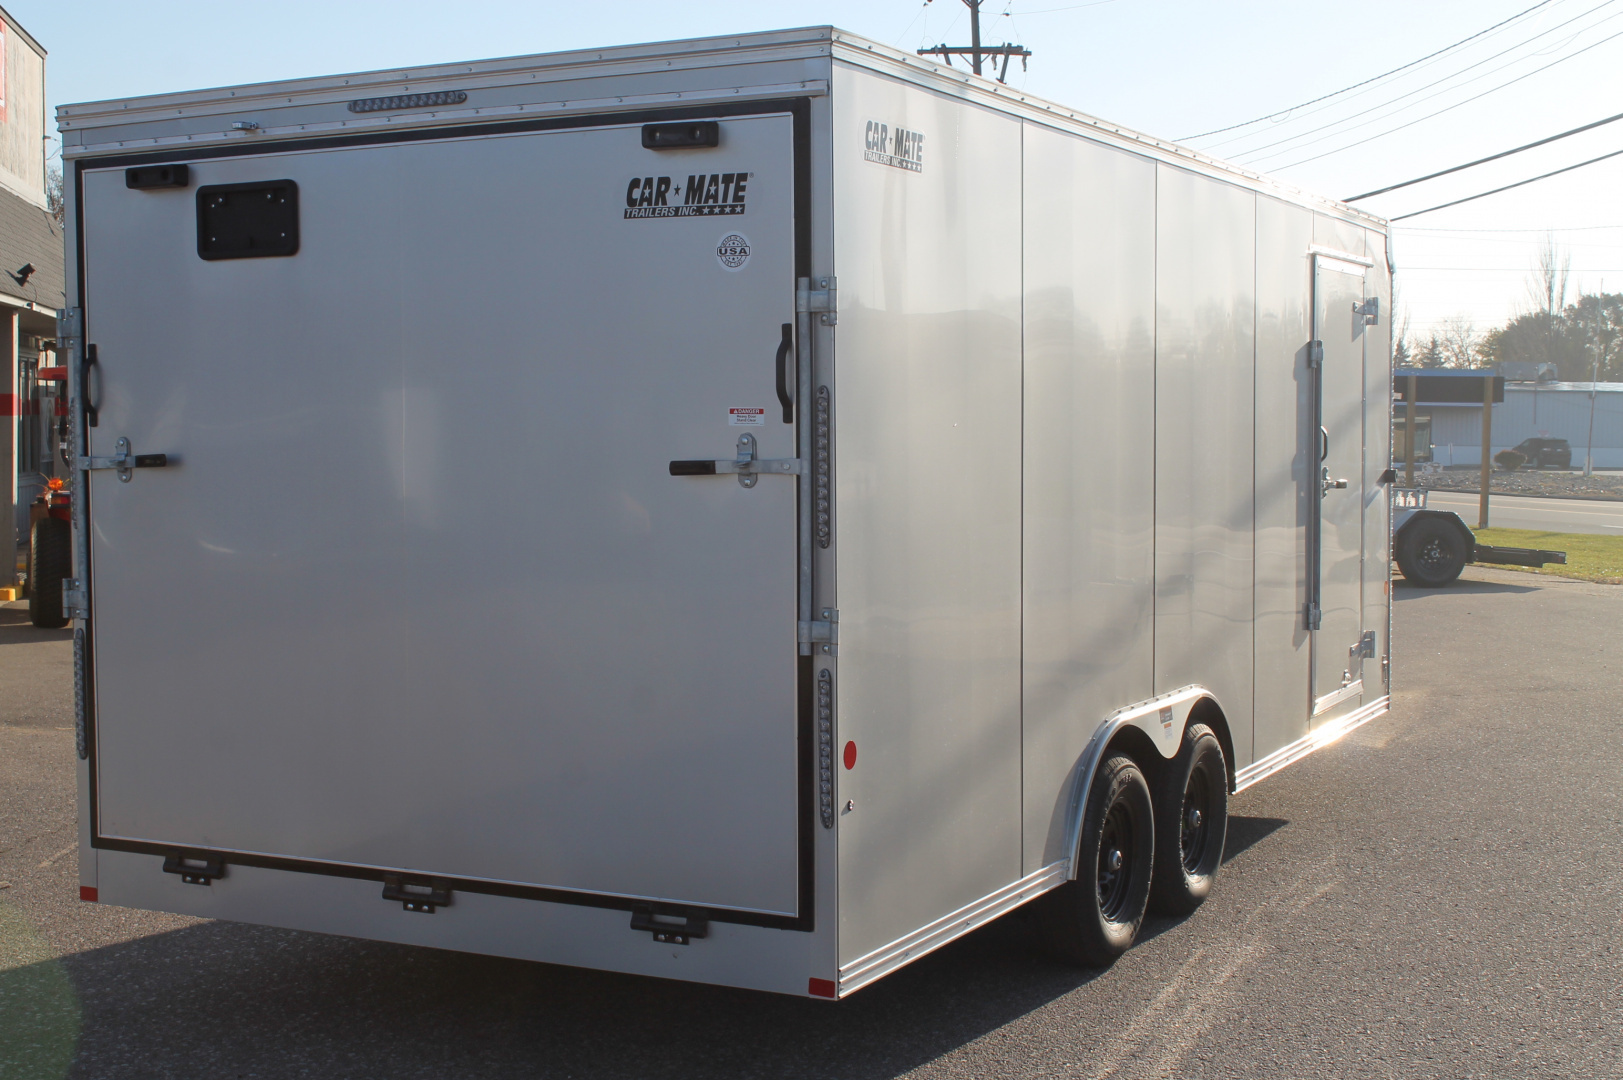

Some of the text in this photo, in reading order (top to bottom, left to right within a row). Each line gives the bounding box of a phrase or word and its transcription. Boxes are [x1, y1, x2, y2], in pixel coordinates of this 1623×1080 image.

[865, 120, 924, 162] CAR MATE
[865, 151, 890, 165] TRAILERS
[626, 172, 749, 208] CAR MATE
[626, 205, 699, 218] TRAILERS INC.
[718, 247, 748, 256] USA
